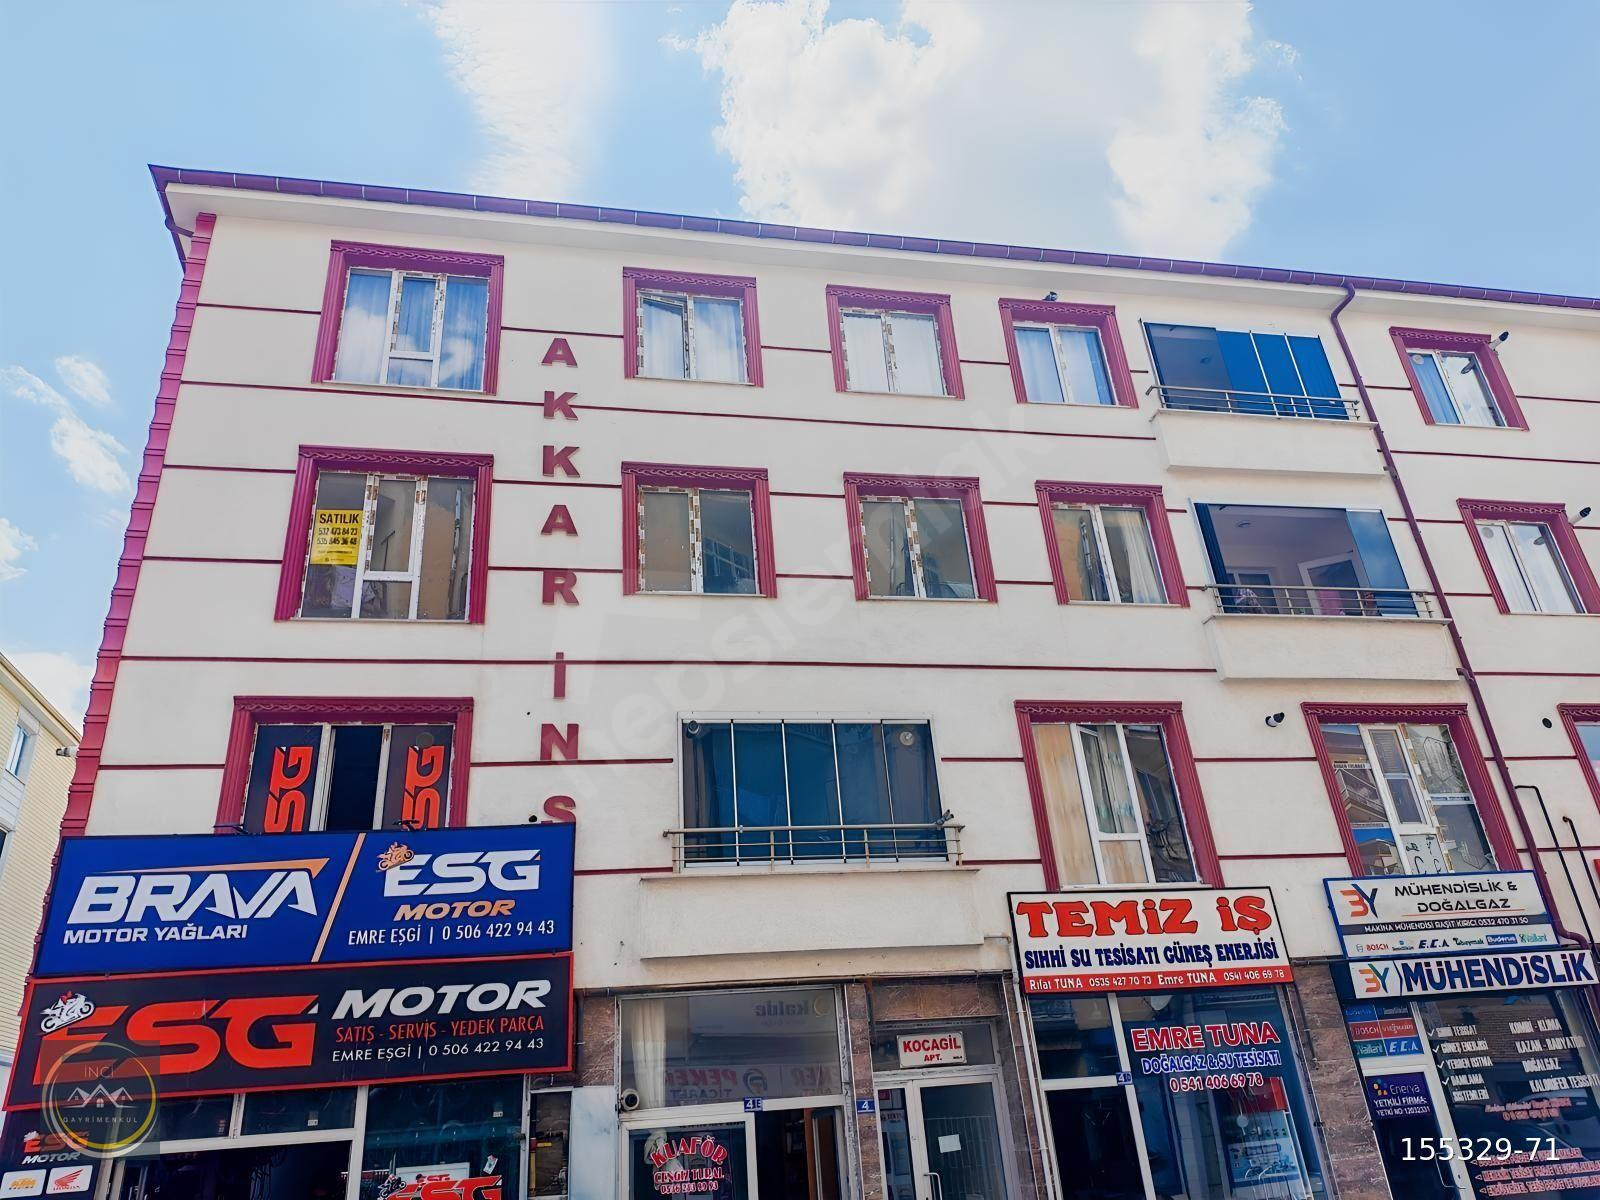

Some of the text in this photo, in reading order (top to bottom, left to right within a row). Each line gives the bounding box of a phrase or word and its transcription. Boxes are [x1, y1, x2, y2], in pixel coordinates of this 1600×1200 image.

[319, 513, 359, 524] SATILIK
[383, 849, 541, 898] ESG
[66, 870, 318, 924] BRAVA
[1394, 879, 1518, 897] MÜHENDİSLİK &
[393, 899, 516, 922] MOTOR
[1417, 898, 1511, 913] DOĞALGAZ
[63, 922, 248, 944] MOTOR YAĞLARI
[348, 919, 555, 946] EMRE EŞGİ 0 506 422 94 43
[1025, 937, 1279, 969] SIHHİ SU TESİSATI GÜNEŞ ENERJİSİ
[1054, 978, 1083, 989] TUNA
[1089, 977, 1110, 987] 0535
[1112, 977, 1126, 986] 427
[1129, 976, 1140, 985] 70
[1142, 975, 1152, 985] 73
[1157, 974, 1184, 985] Emre
[1186, 973, 1217, 984] TUNA
[1223, 972, 1242, 982] 0541
[1244, 971, 1260, 980] 406
[1262, 970, 1273, 979] 69
[1275, 969, 1285, 979] 78
[32, 979, 552, 1086] ESG MOTOR
[335, 1015, 544, 1045] SATIŞ SERVİS YEDEK PARÇA
[1131, 1021, 1282, 1052] EMRE TUNA
[332, 1038, 544, 1062] EMRE EŞGİ 0 506 422 94 43
[903, 1035, 962, 1053] KOCAGİL
[924, 1053, 942, 1062] APT.
[1141, 1048, 1282, 1075] DOĞALGAZ & SU TESİSATI
[1170, 1072, 1263, 1092] 0 541 406 69 78
[1390, 1084, 1420, 1095] Enerya
[861, 1101, 870, 1110] 4
[22, 1152, 81, 1165] MOTOR
[650, 1135, 728, 1168] KUAFÖR
